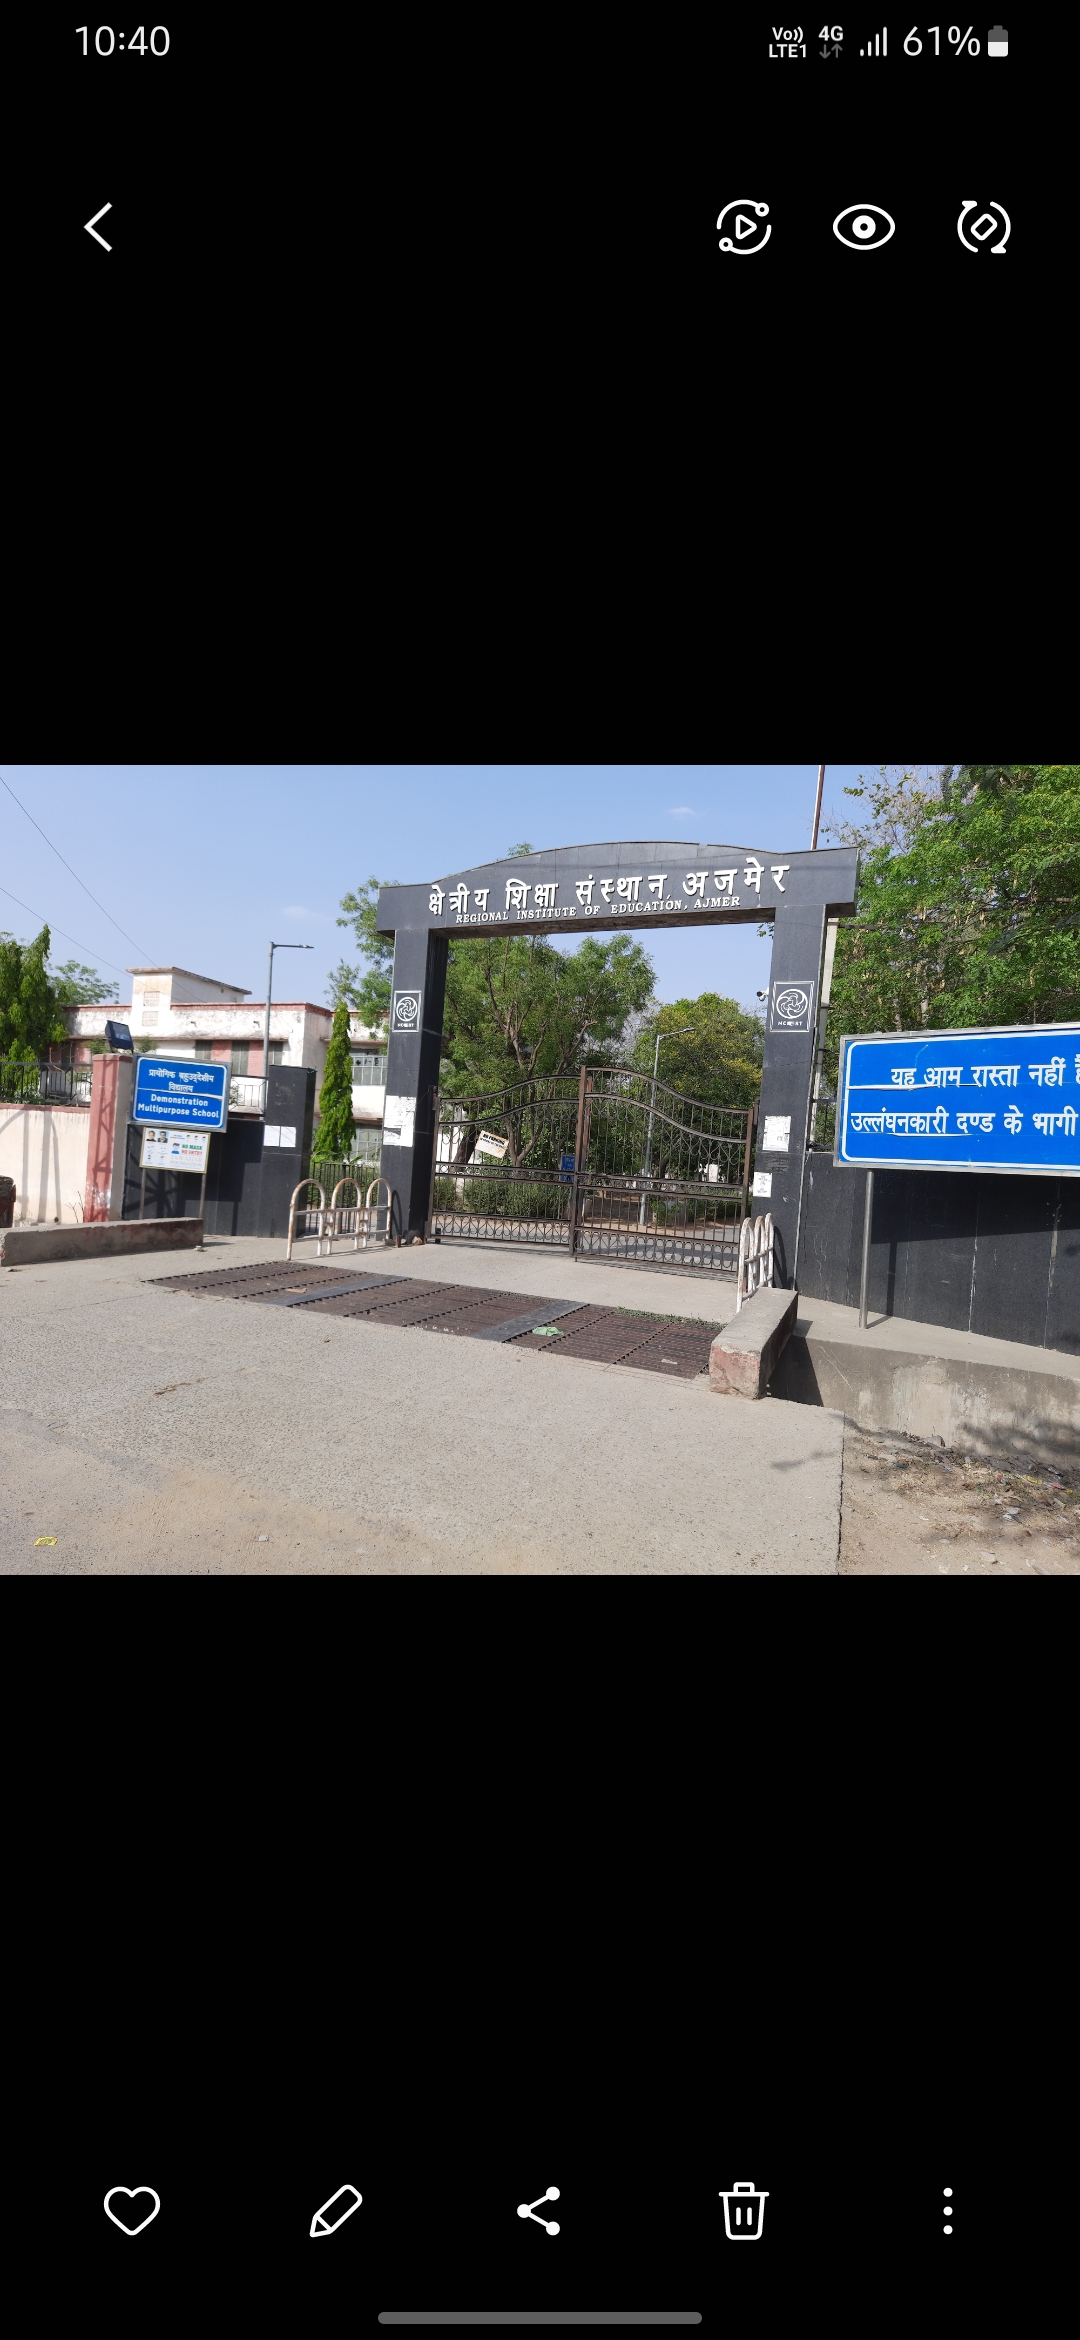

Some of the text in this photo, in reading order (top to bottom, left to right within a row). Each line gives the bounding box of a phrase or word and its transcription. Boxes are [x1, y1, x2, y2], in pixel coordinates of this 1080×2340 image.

[428, 883, 490, 915] क्षेत्रीय
[505, 878, 559, 910] शिक्षा
[682, 856, 790, 898] अजमेर
[455, 911, 509, 924] REGIONAL
[516, 906, 577, 920] INSTITUTE
[584, 905, 601, 916] OF
[693, 895, 741, 909] AJMER
[148, 1068, 176, 1078] प्रायोगिक
[891, 1067, 917, 1088] यह
[923, 1066, 964, 1088] आम
[970, 1065, 1021, 1087] रास्ता
[1028, 1056, 1067, 1087] नहीं
[168, 1081, 194, 1093] विद्यालय
[151, 1094, 208, 1106] Demonstration
[138, 1104, 219, 1119] Multipurpose School
[850, 1105, 1079, 1136] उल्लंघनकारी दण्ड के भागी
